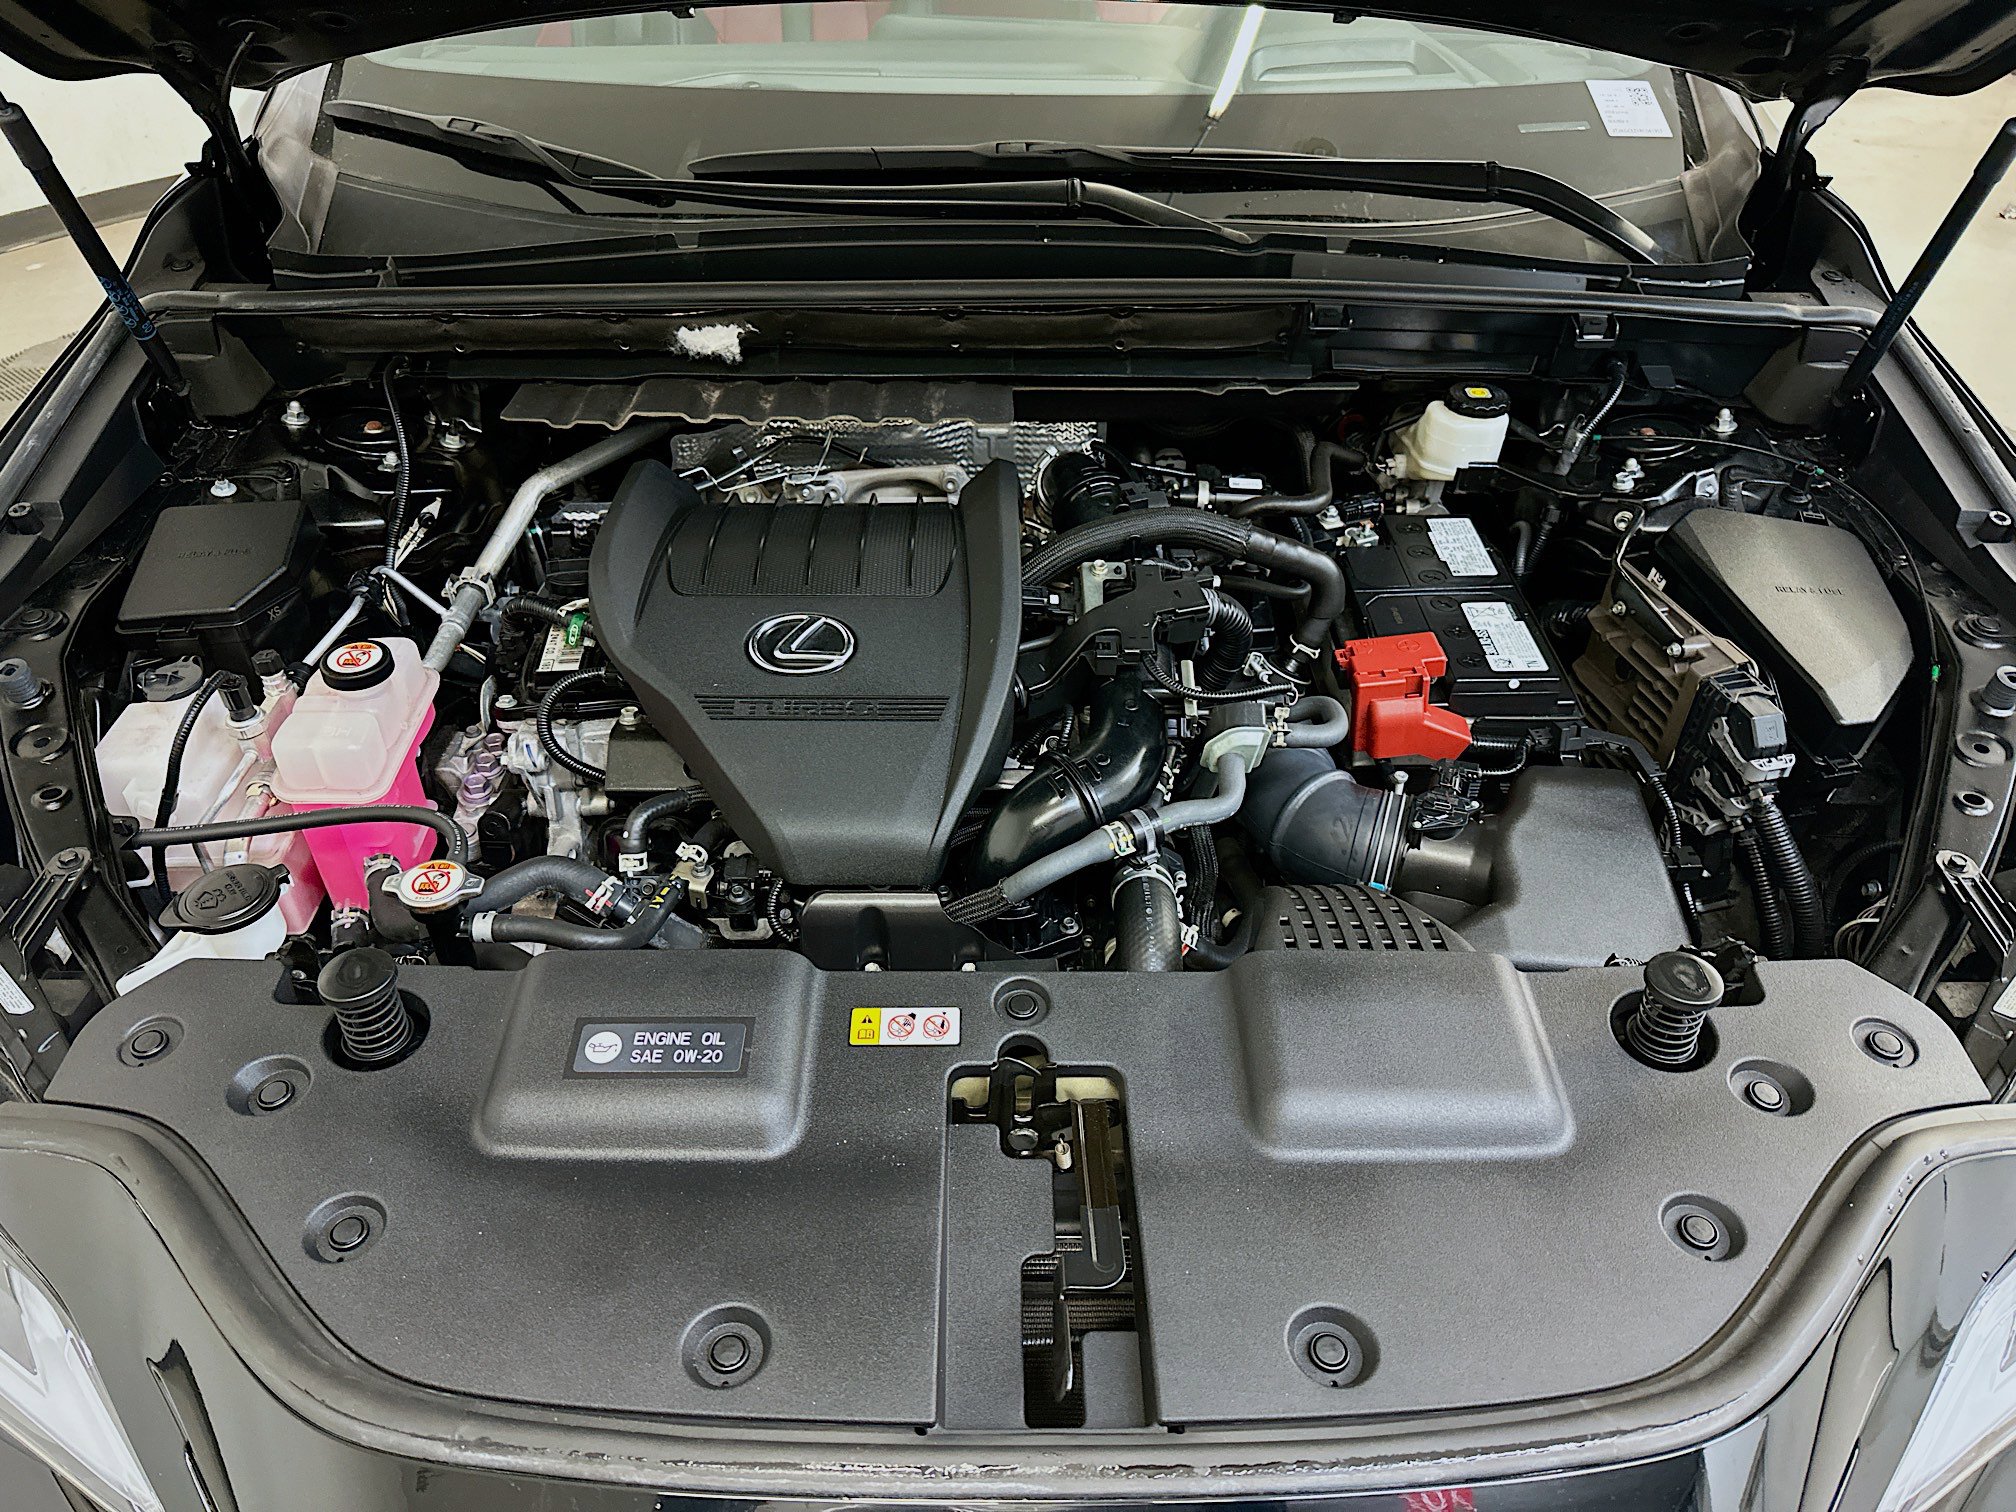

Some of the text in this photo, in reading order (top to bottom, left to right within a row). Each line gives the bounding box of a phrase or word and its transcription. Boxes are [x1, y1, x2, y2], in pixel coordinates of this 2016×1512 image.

[736, 698, 880, 718] TURBO
[633, 1031, 726, 1046] ENGINE OIL
[630, 1049, 724, 1064] SAE 0W-20
